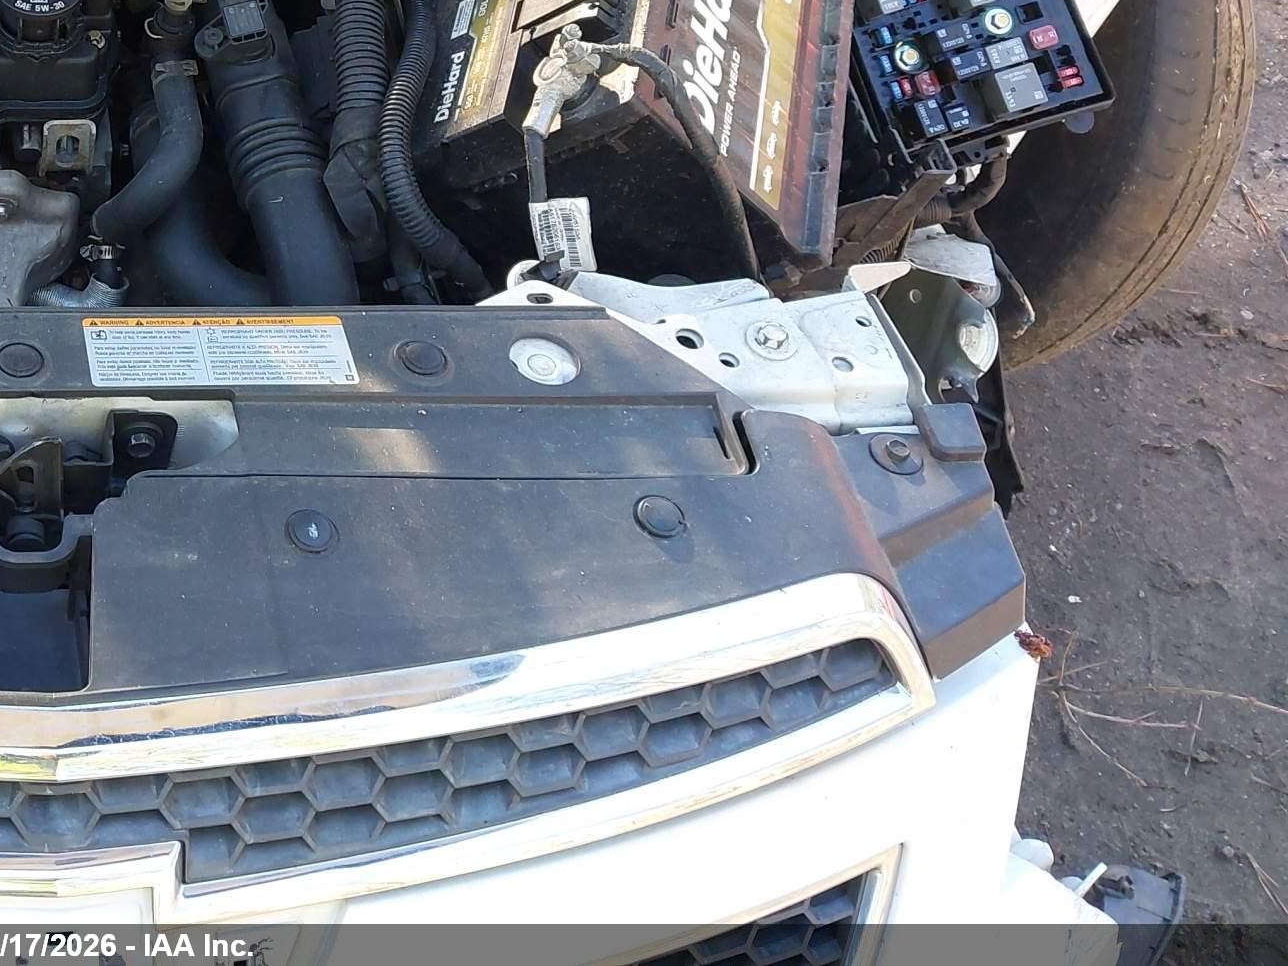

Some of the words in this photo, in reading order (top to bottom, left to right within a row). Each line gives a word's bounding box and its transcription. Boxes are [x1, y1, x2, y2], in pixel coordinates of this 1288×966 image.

[14, 0, 32, 11] SAE
[35, 0, 65, 12] 5W-30
[434, 51, 466, 123] DieHard
[727, 52, 741, 104] AHEAD
[720, 110, 735, 157] POWER
